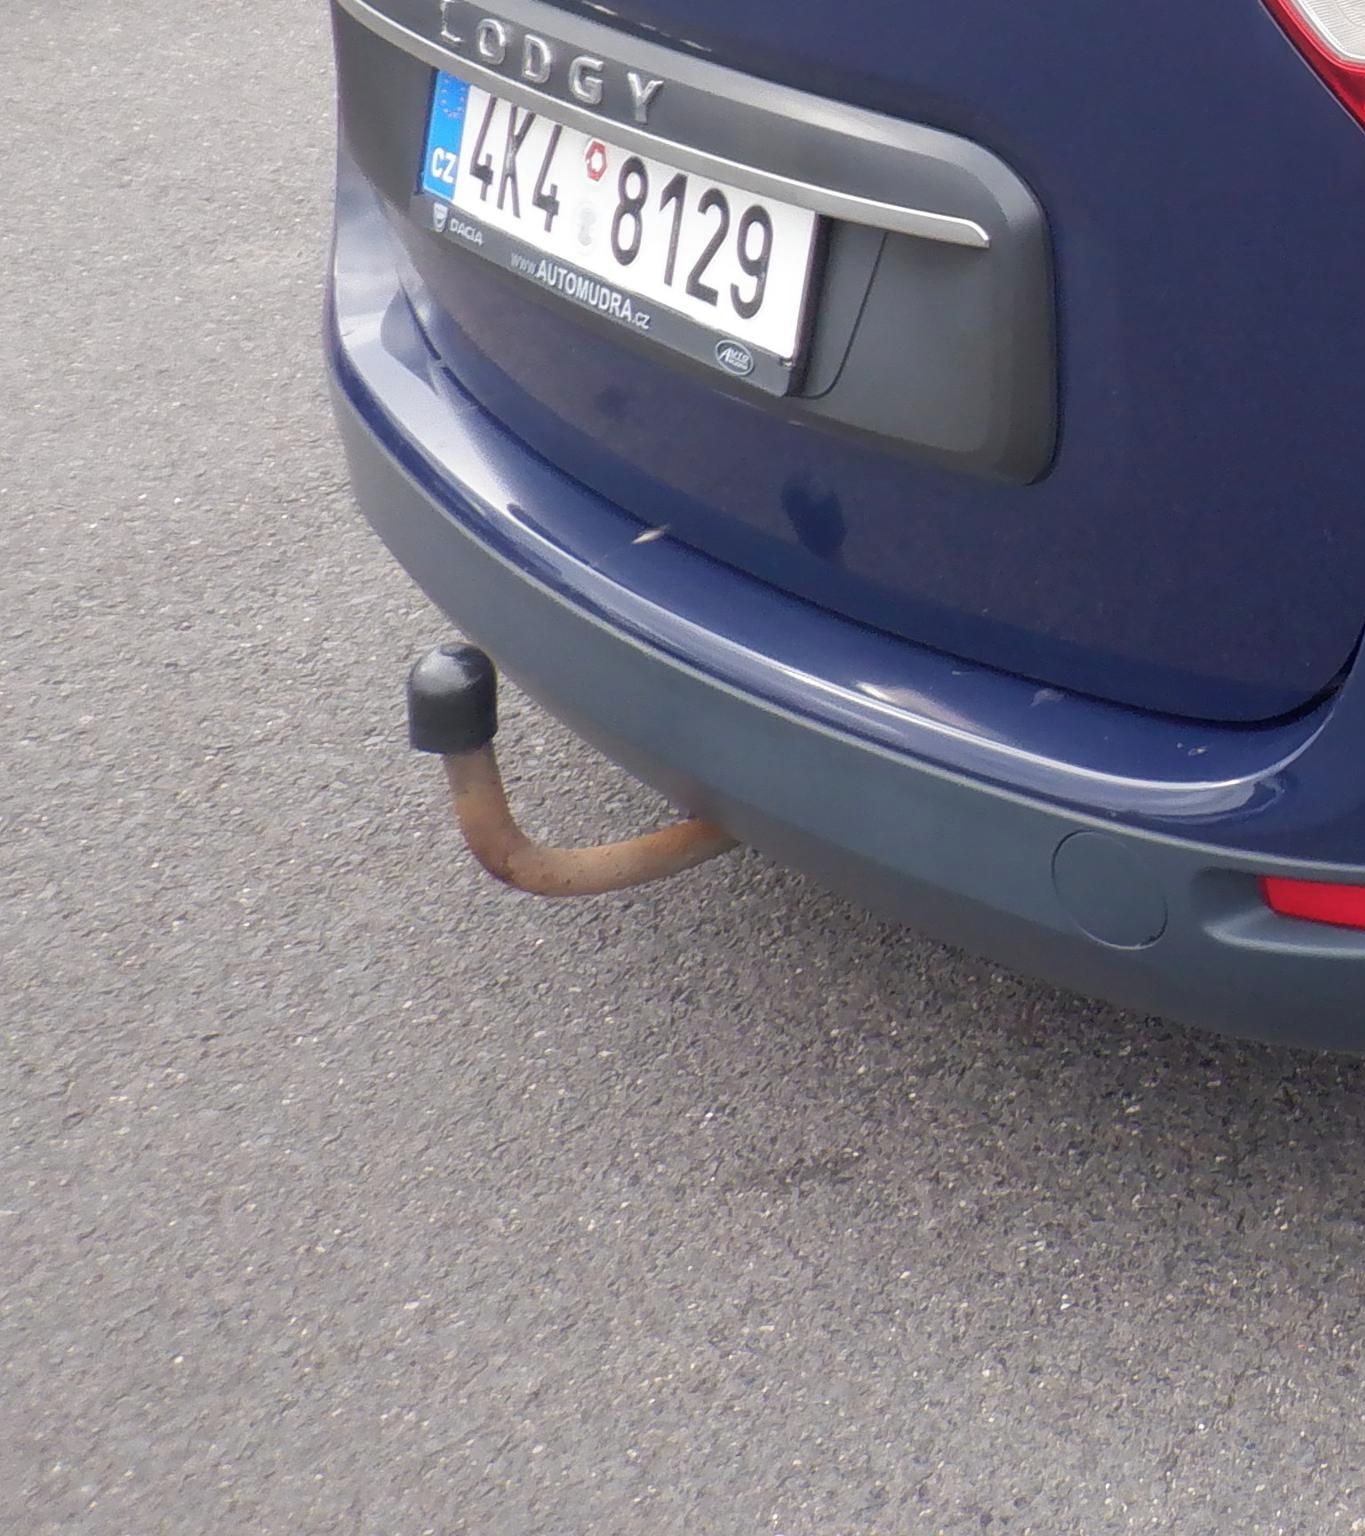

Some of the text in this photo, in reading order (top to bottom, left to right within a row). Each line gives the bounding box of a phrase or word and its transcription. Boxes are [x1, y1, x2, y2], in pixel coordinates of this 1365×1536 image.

[431, 146, 458, 184] CZ
[469, 96, 774, 320] 4K4 8129
[450, 218, 485, 246] DACIA
